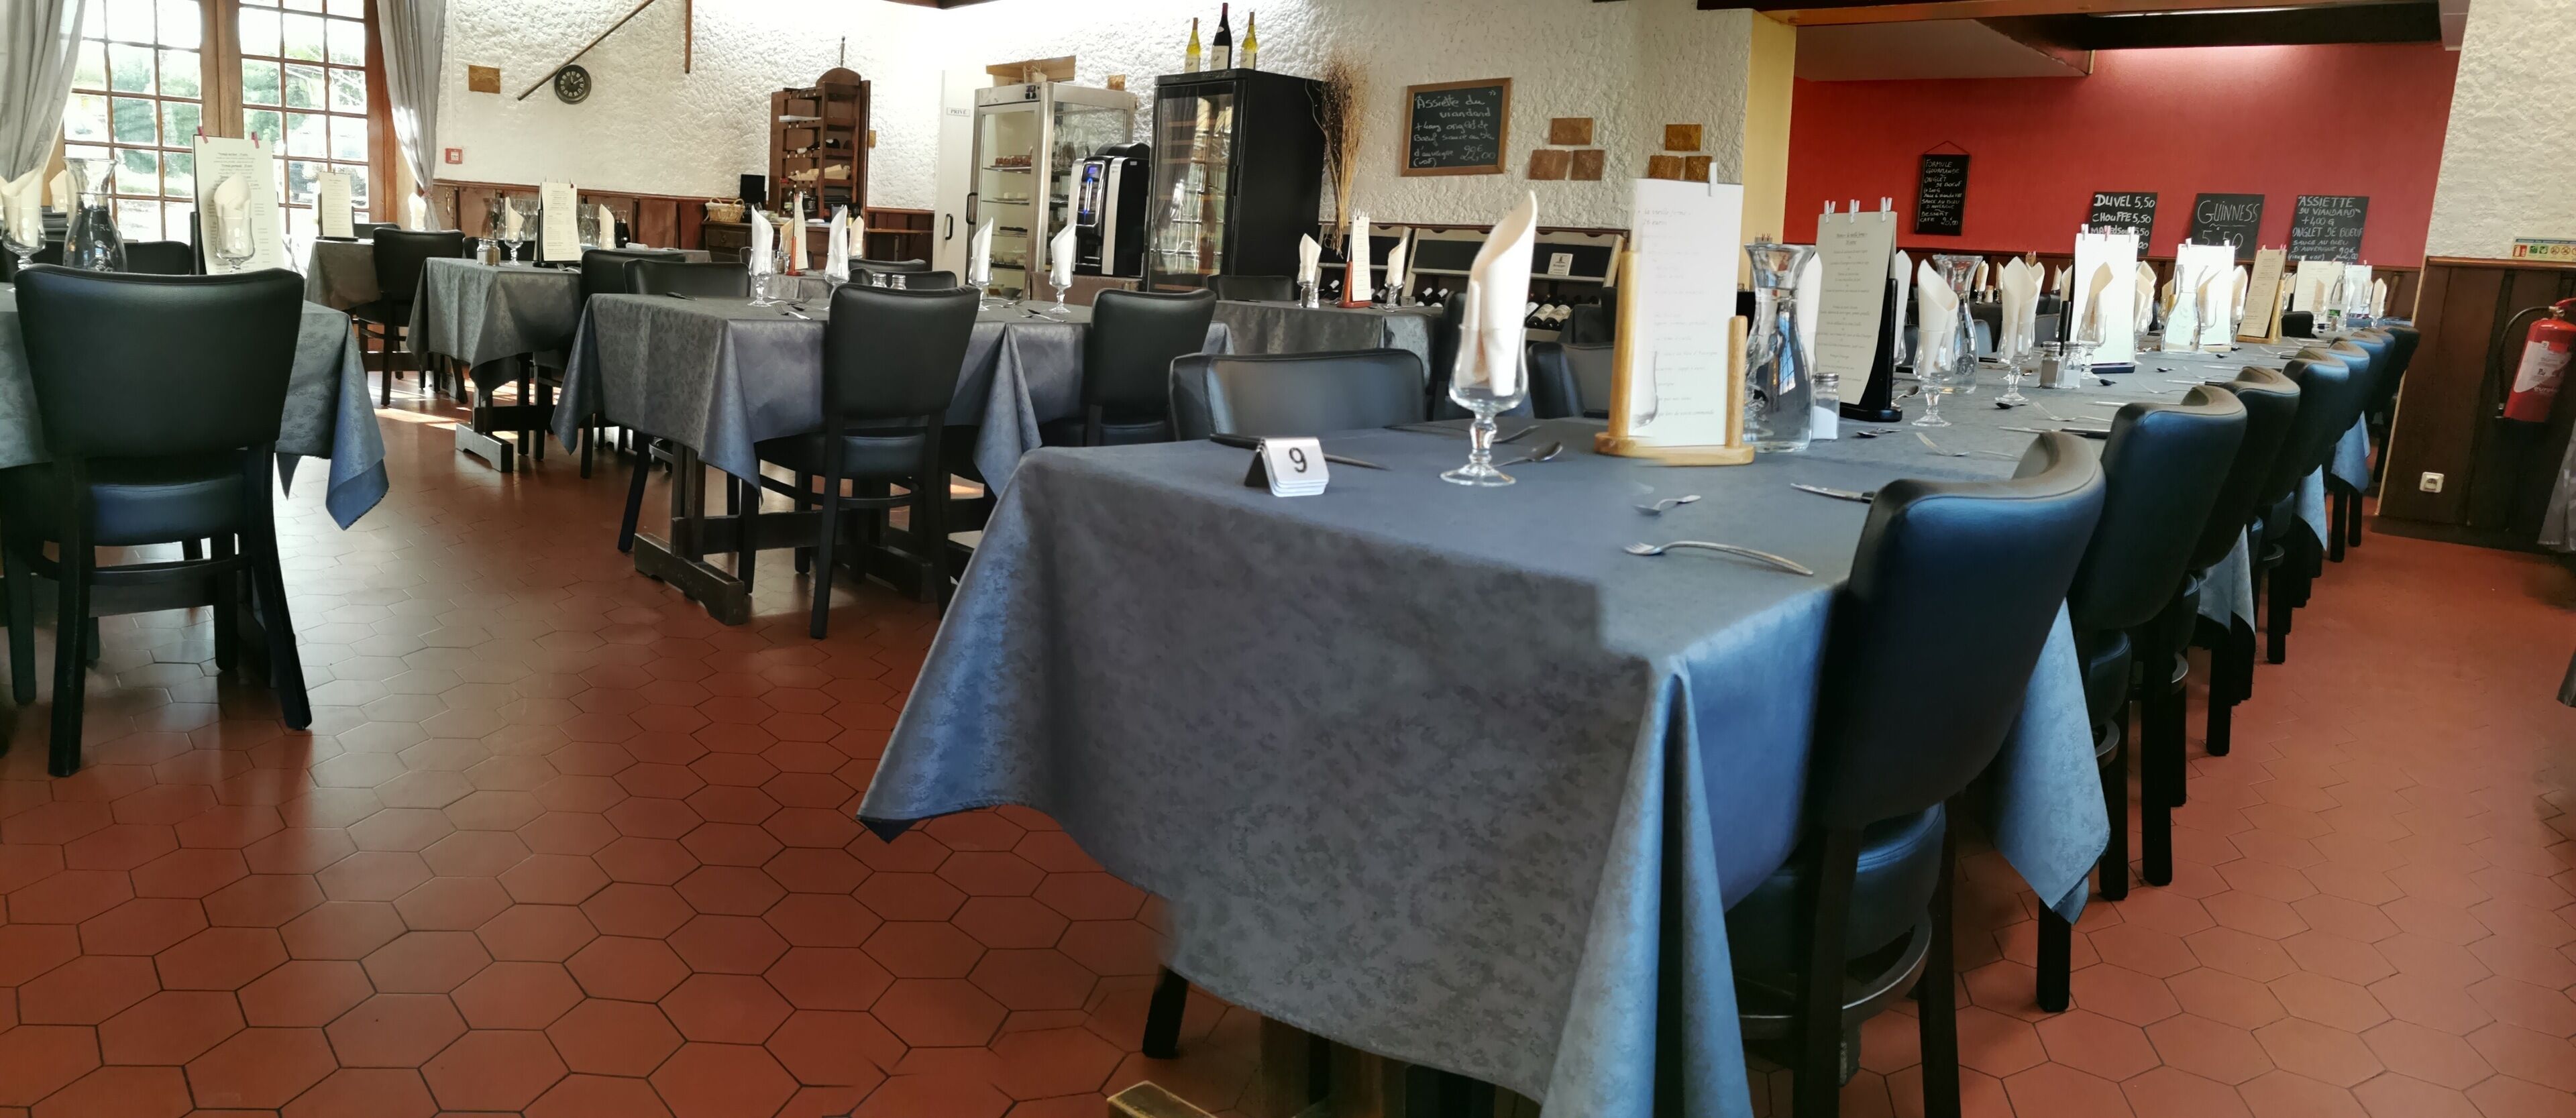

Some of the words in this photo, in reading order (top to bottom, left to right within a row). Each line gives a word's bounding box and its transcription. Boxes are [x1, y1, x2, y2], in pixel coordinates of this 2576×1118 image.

[1925, 159, 1953, 168] FORMULE
[1924, 176, 1947, 184] ONGLET
[2094, 194, 2131, 207] DUVEL
[2135, 196, 2155, 209] 5,50
[2198, 200, 2260, 224] GUINNESS
[2133, 213, 2151, 225] 5,50
[2292, 227, 2323, 237] ONGLET
[1289, 447, 1307, 473] 9
